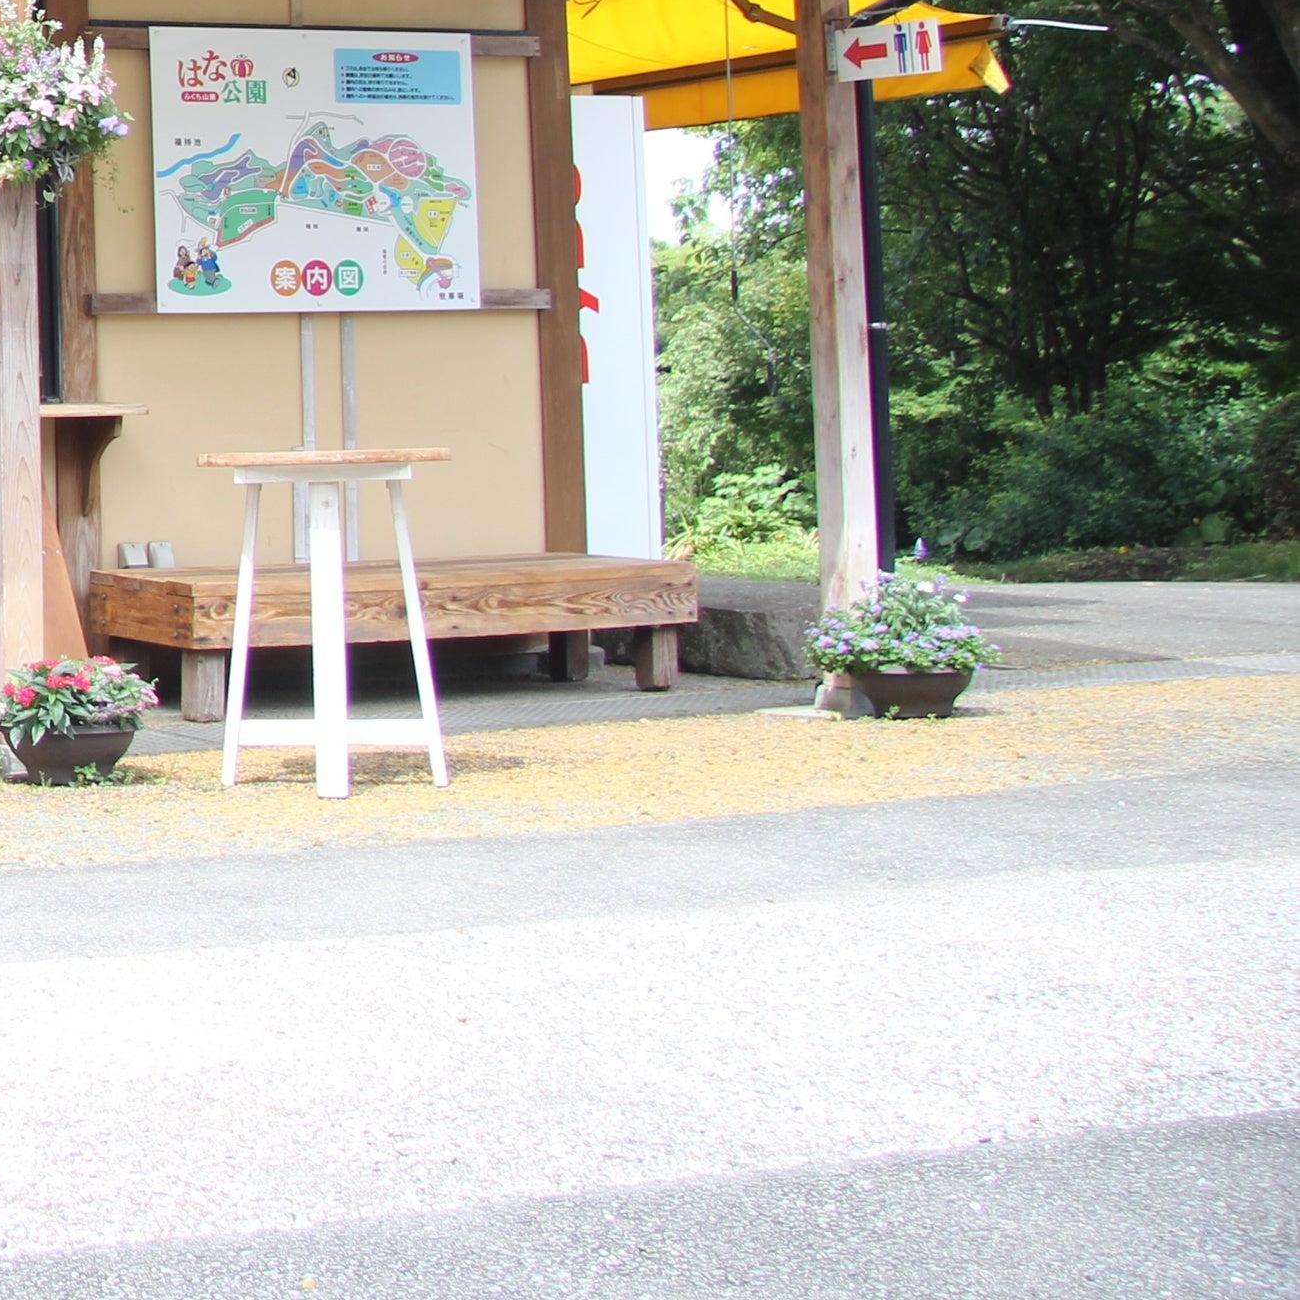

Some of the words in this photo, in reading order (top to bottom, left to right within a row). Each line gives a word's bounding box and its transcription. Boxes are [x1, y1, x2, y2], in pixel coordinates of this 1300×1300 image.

[177, 50, 228, 88] はな
[380, 54, 411, 63] お知らせ
[221, 79, 267, 105] 公園
[275, 265, 360, 290] 案内図
